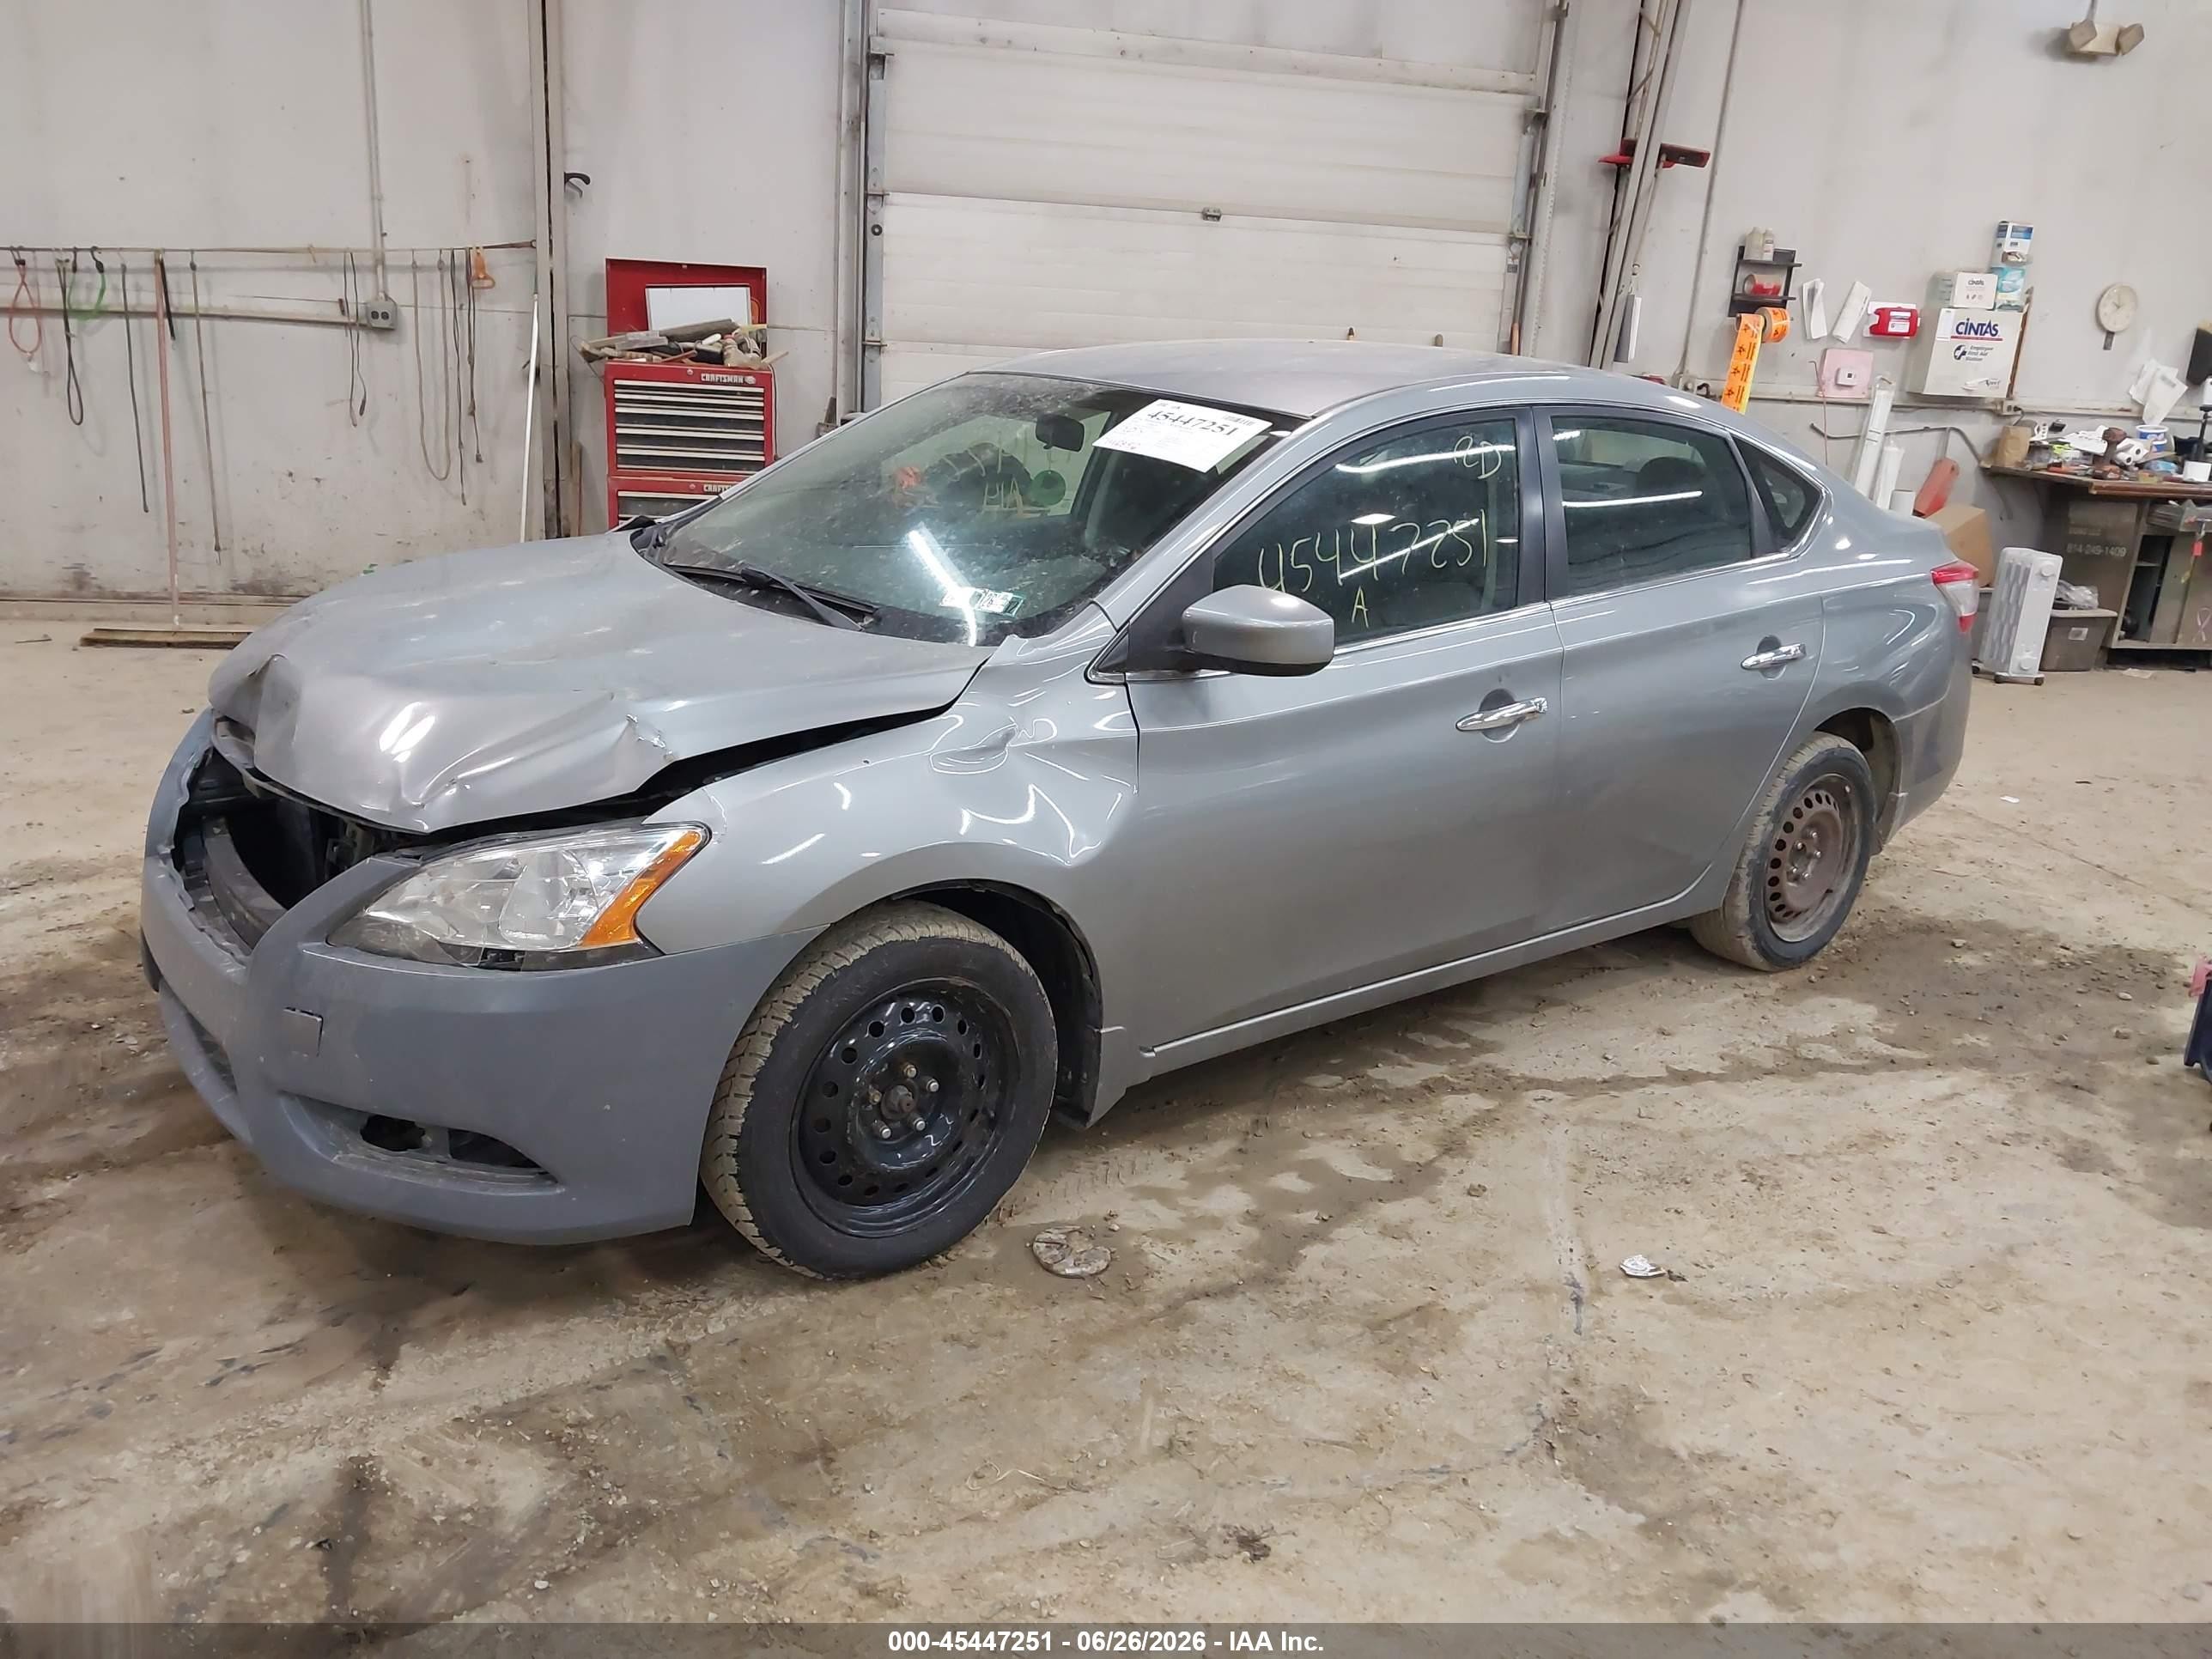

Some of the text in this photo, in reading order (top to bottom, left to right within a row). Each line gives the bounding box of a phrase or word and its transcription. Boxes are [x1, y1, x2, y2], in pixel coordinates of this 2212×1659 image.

[1955, 318, 1999, 337] CINTAS
[701, 373, 744, 384] CRAFTSMAN
[1147, 410, 1239, 436] 45447251
[1258, 508, 1487, 592] 45447251
[1352, 586, 1370, 629] A
